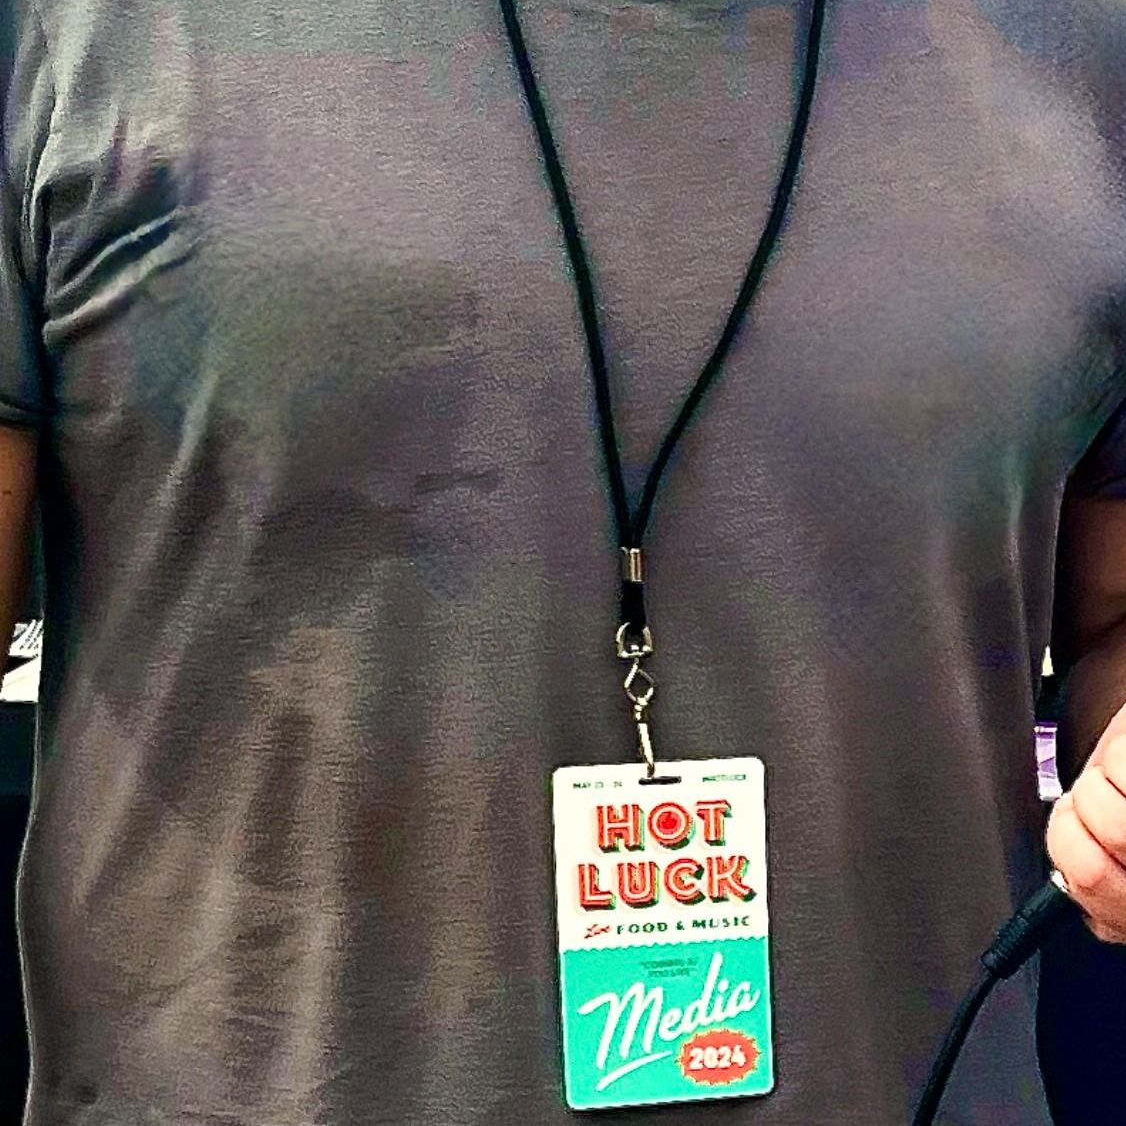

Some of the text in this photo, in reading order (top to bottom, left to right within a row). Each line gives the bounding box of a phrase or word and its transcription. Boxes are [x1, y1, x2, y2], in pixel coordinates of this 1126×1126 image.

[596, 799, 732, 853] HOT
[577, 855, 758, 912] LUCK
[617, 921, 668, 935] FOOD
[676, 920, 685, 931] &
[692, 915, 751, 929] MUSIC
[577, 951, 760, 1070] Media
[688, 1045, 746, 1071] 2024
